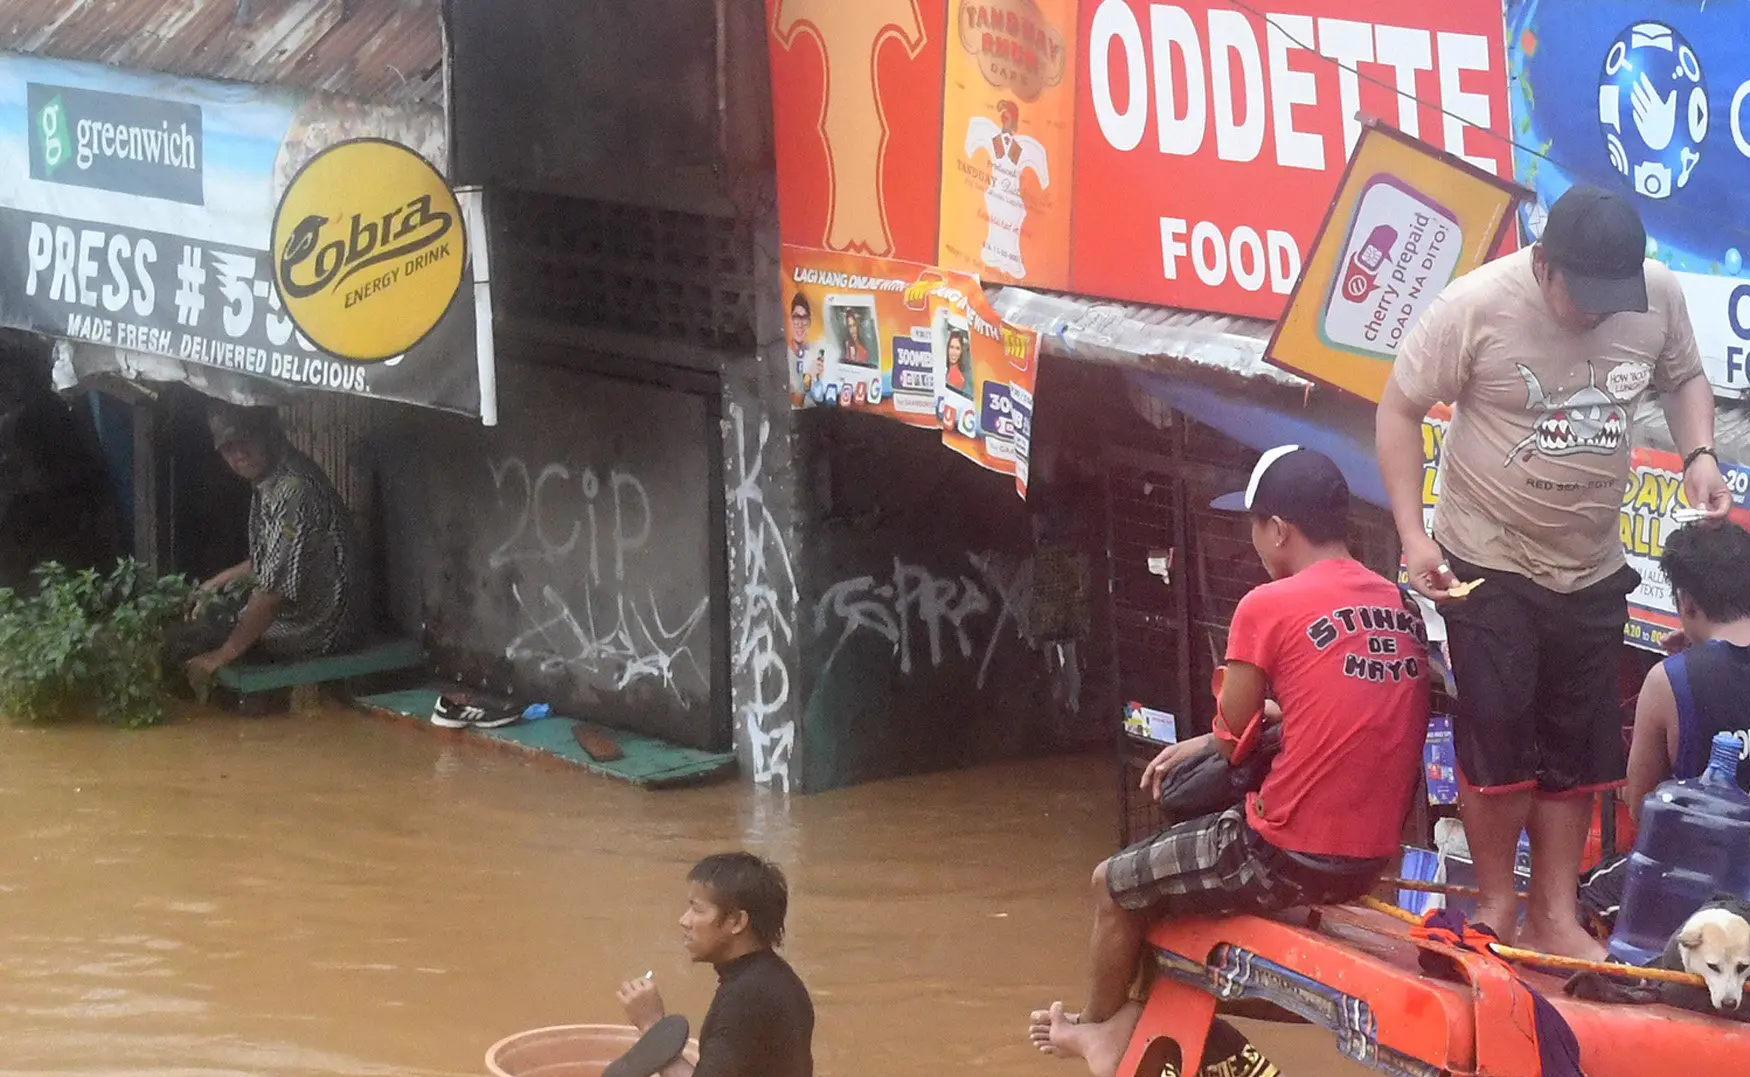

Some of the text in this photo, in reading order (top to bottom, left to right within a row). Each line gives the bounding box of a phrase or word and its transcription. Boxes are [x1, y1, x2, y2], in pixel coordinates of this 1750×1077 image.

[1090, 0, 1497, 175] ODDETTE
[76, 118, 196, 171] greenwich
[26, 221, 158, 317] PRESS
[281, 194, 452, 298] Cobra
[345, 244, 450, 309] ENERGY DRINK
[1159, 217, 1300, 295] FOOD
[1364, 212, 1430, 341] cherry prepaid
[1386, 224, 1449, 349] LOAD NA DITO!
[67, 313, 370, 392] MADE FRESH. DELIVERED DELICIOUS.
[1526, 479, 1553, 491] RED
[1343, 652, 1419, 682] MAYO
[1368, 636, 1397, 655] DE
